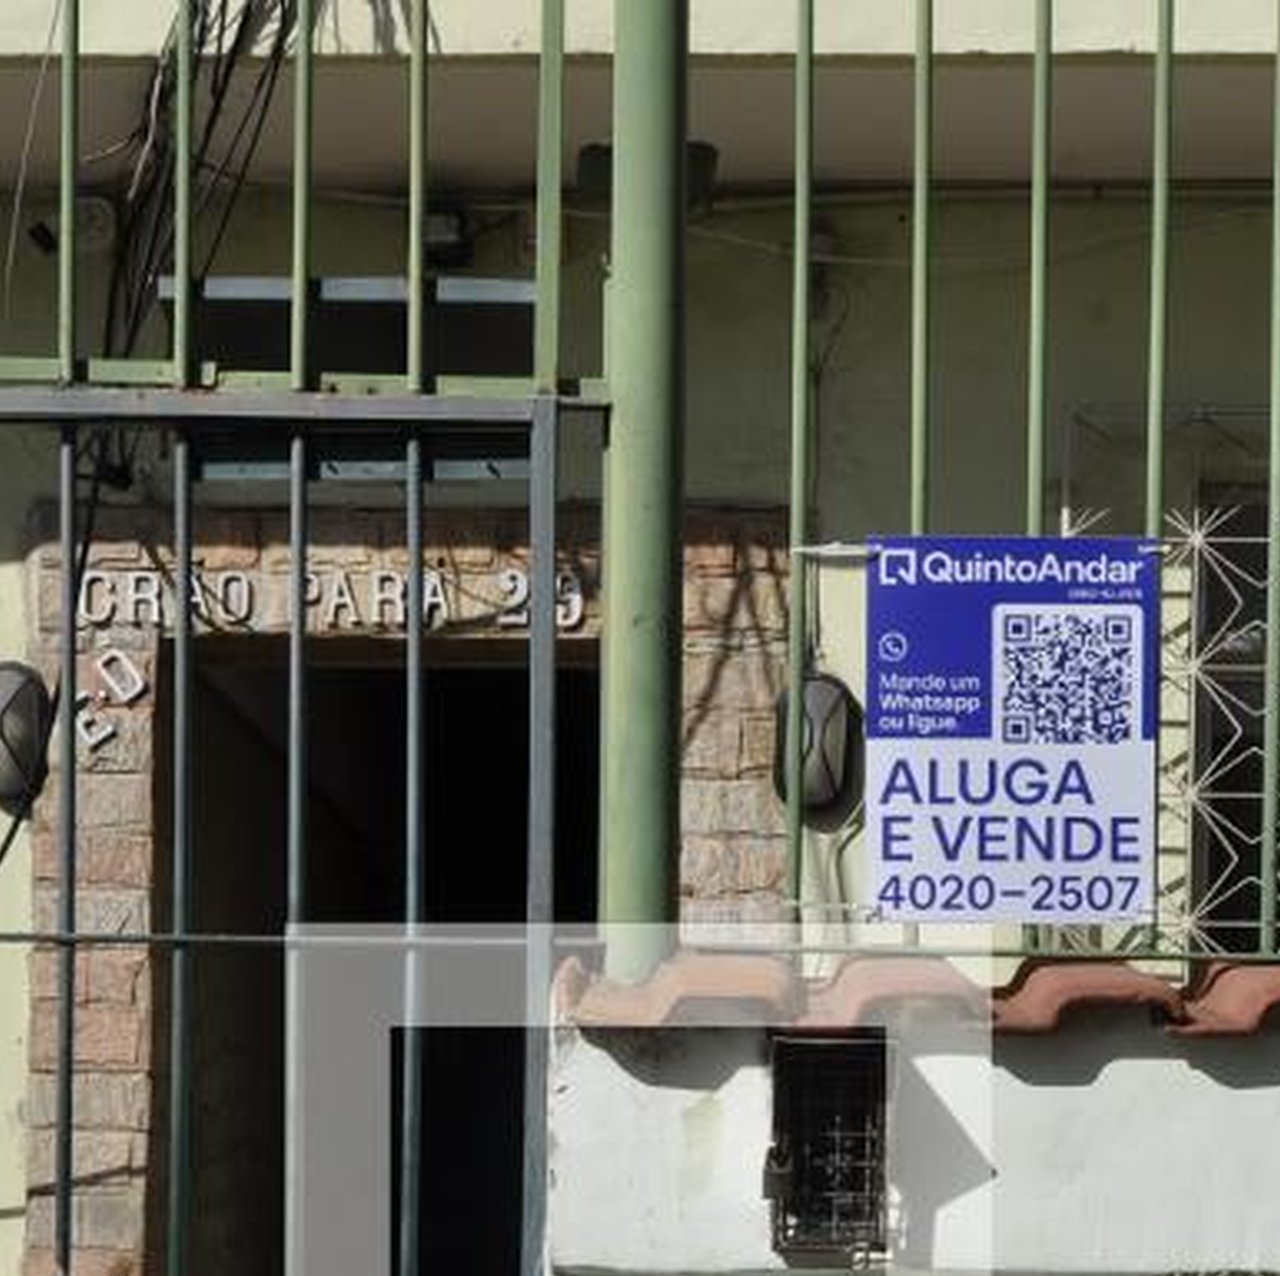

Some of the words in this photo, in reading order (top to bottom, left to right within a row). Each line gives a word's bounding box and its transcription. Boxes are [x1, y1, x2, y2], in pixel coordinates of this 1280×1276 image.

[923, 551, 1143, 585] QuintoAndar
[879, 673, 946, 692] Mande
[949, 677, 981, 692] um
[878, 694, 981, 714] Whatsapp
[879, 716, 904, 729] ou
[879, 759, 1095, 806] ALUGA
[881, 816, 912, 861] E
[932, 816, 1141, 862] VENDE
[878, 875, 1140, 912] 4020-2507
